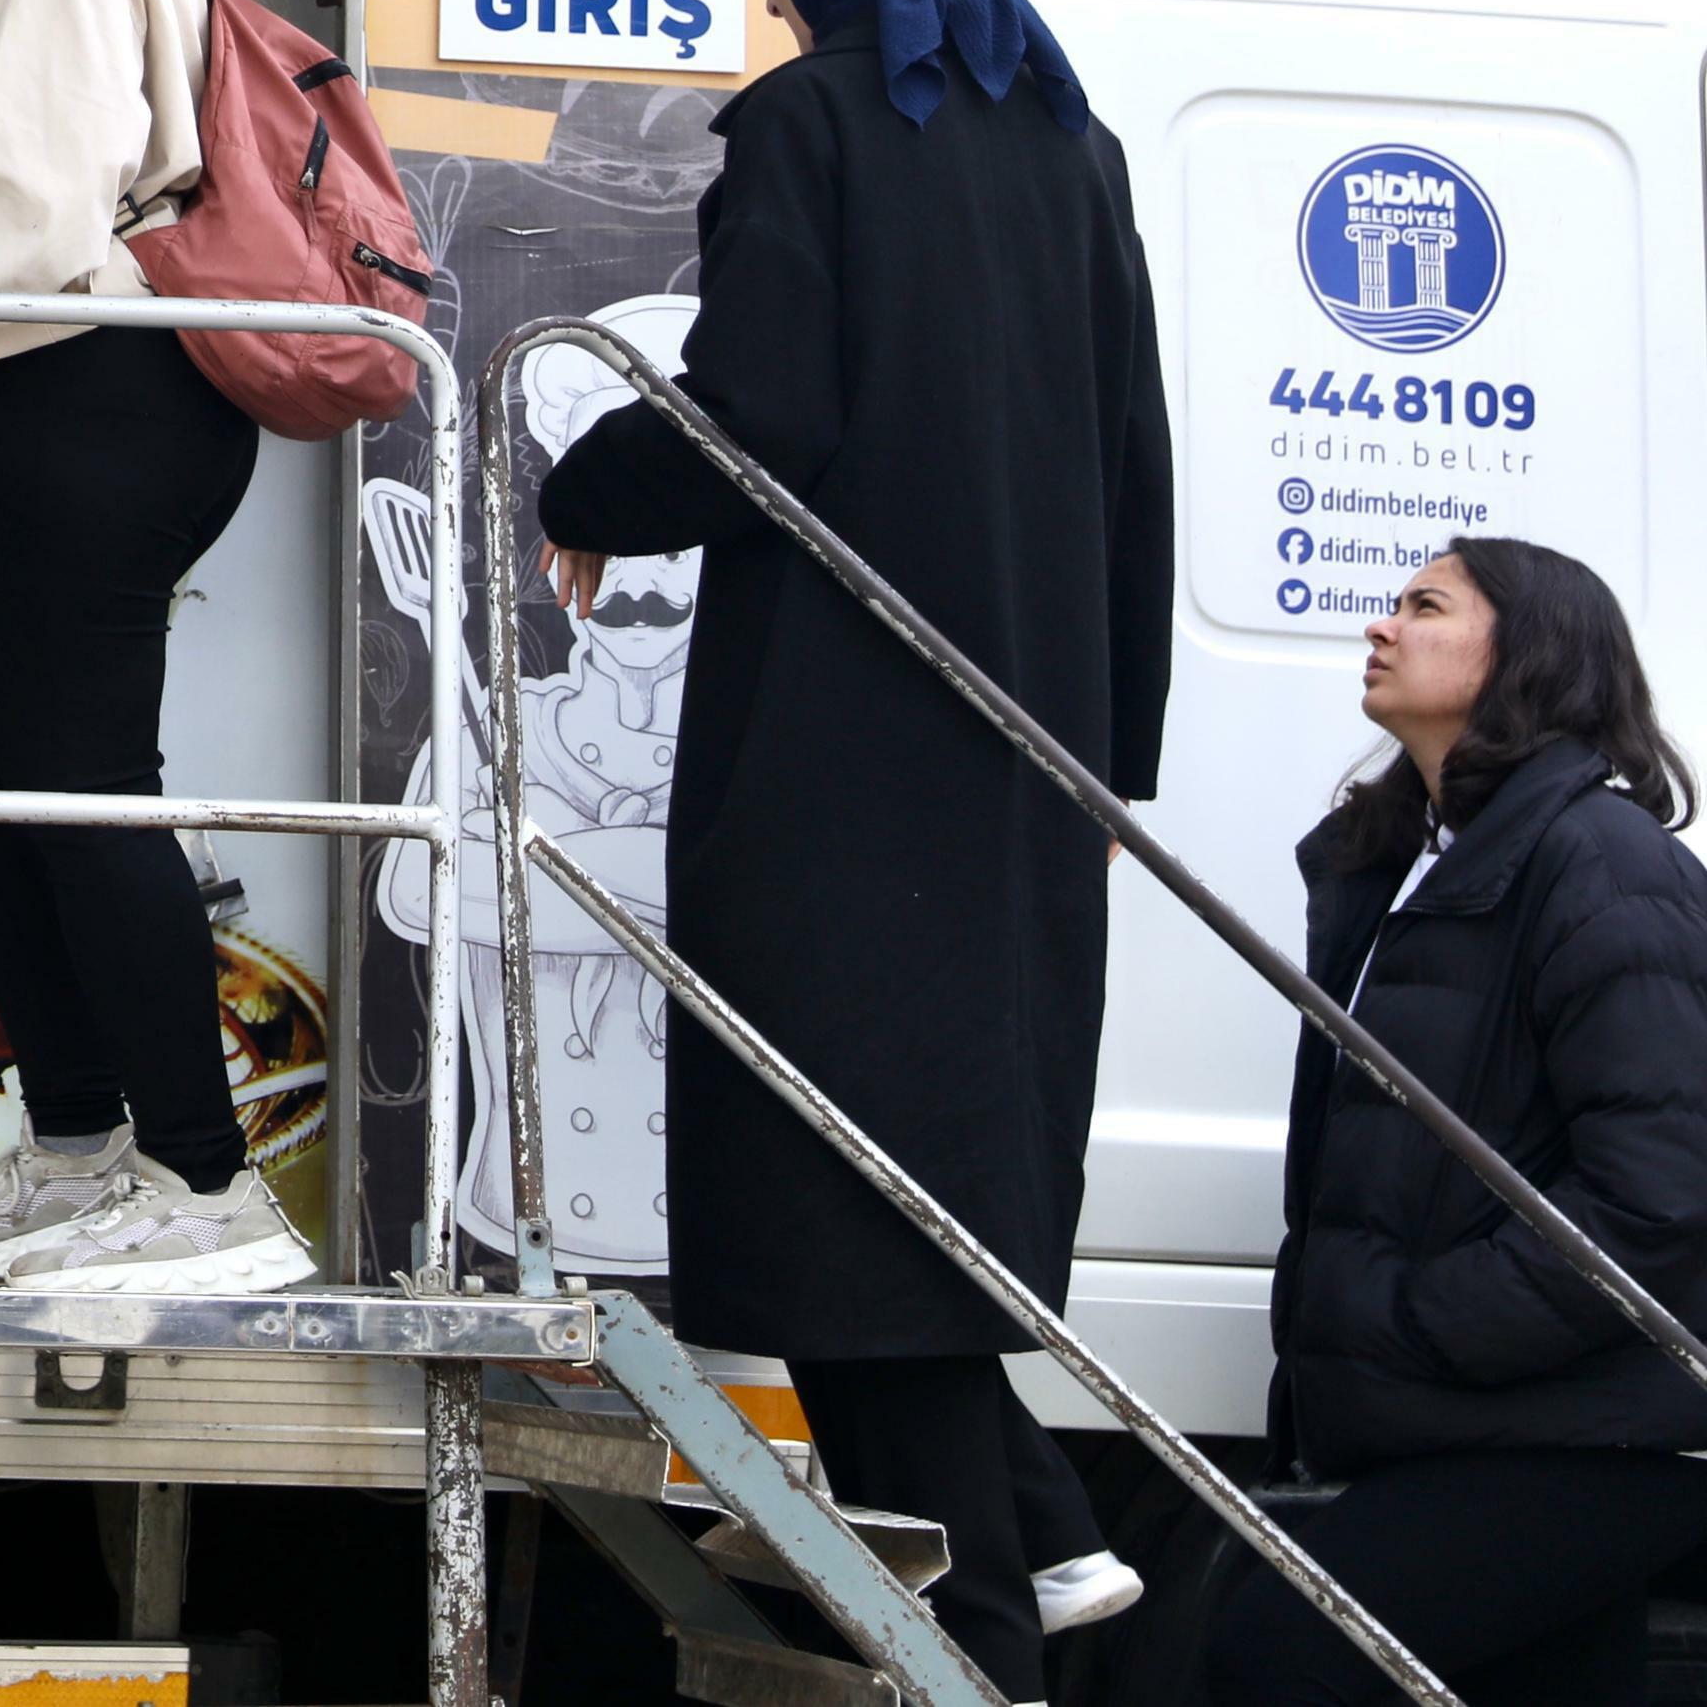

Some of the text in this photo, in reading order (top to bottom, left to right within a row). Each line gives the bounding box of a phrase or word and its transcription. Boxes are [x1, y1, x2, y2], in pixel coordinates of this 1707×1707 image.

[1343, 168, 1456, 210] DİDİM
[1347, 204, 1456, 230] BELEDİYESİ
[1320, 486, 1488, 528] didimbelediye
